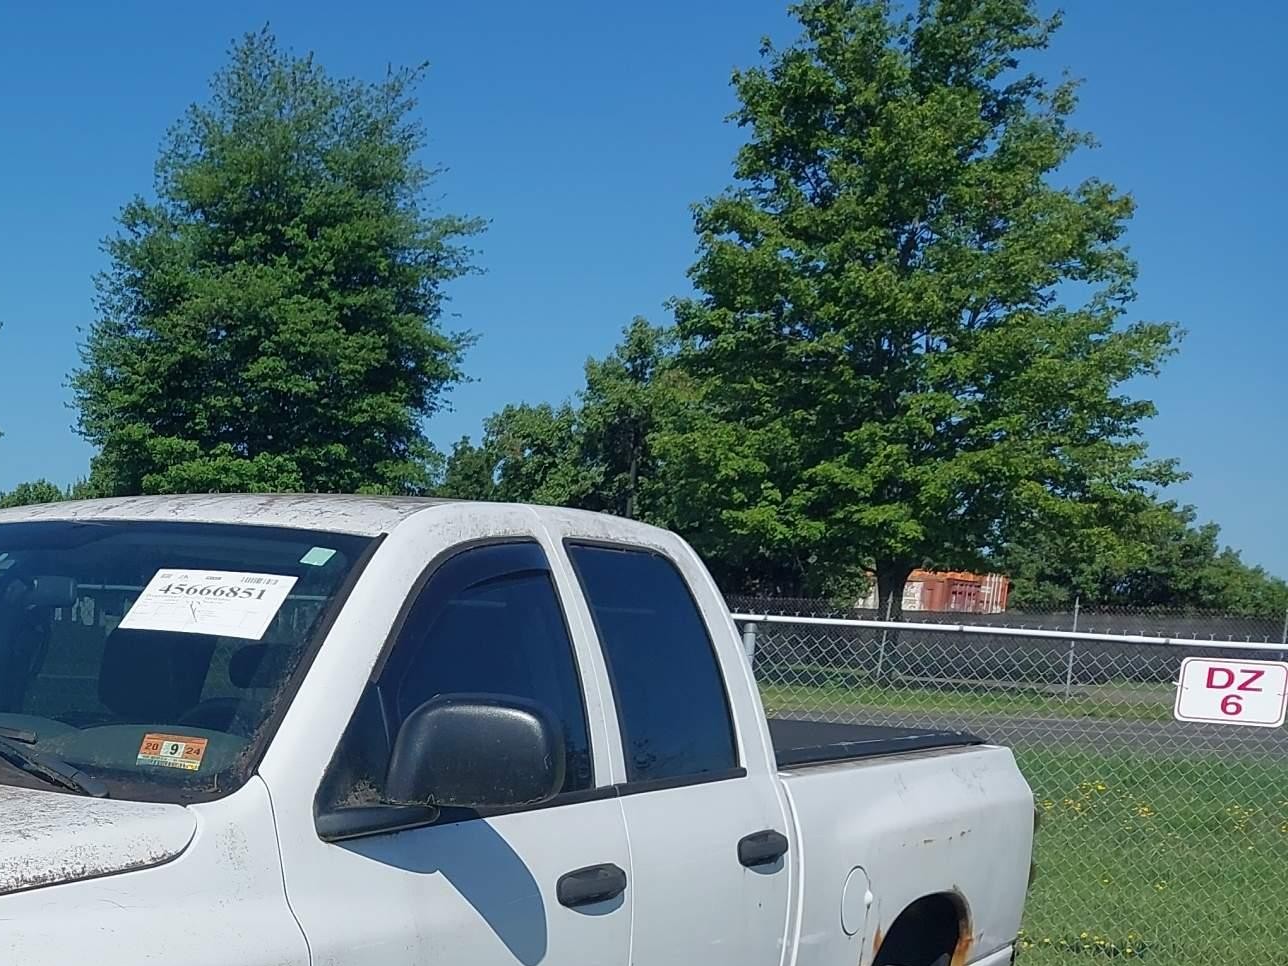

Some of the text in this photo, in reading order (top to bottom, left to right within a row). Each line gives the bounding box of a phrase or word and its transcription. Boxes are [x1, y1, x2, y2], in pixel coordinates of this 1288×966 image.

[158, 583, 268, 600] 45666851
[1205, 667, 1265, 692] DZ
[1220, 694, 1243, 716] 6
[144, 742, 160, 752] 20
[169, 743, 180, 756] 9
